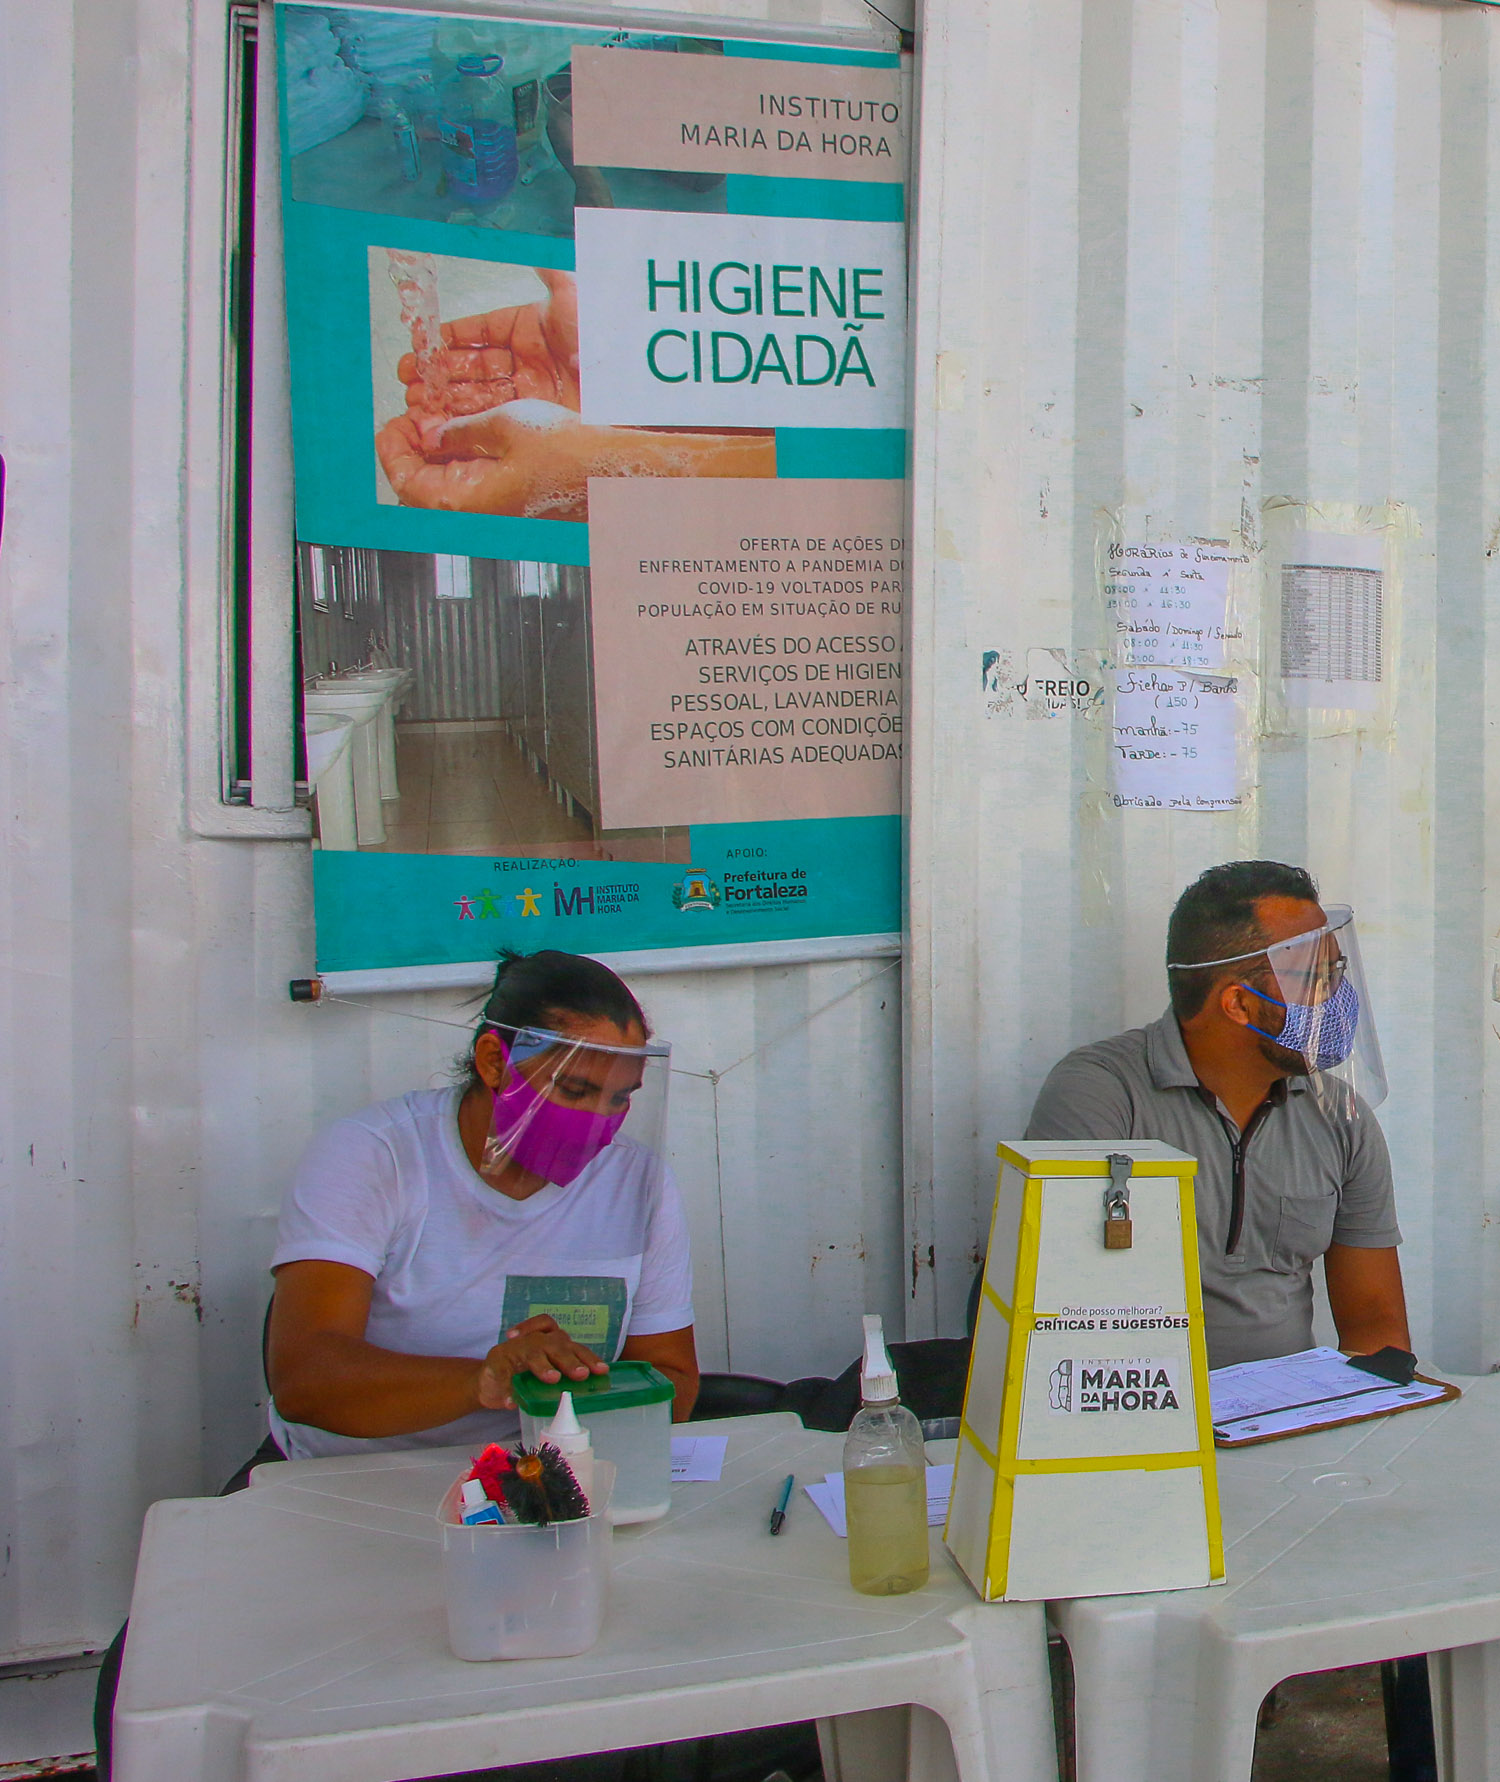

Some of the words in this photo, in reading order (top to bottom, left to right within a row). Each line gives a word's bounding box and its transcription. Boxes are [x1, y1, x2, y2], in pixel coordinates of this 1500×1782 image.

[759, 93, 899, 124] INSTITUTO
[681, 124, 768, 149] MARIA
[776, 130, 813, 152] DA
[821, 133, 892, 158] HORA
[647, 259, 885, 320] HIGIENE
[646, 321, 877, 388] CIDADÃ
[740, 538, 800, 551] OFERTA
[807, 538, 825, 551] DE
[832, 536, 883, 554] AÇÕES
[639, 560, 780, 573] ENFRENTAMENTO
[787, 560, 795, 572] A
[802, 559, 882, 572] PANDEMIA
[698, 581, 775, 595] COVID-19
[782, 581, 864, 594] VOLTADOS
[871, 581, 904, 593] PAR
[1160, 585, 1186, 595] 11:30
[637, 601, 736, 619] POPULAÇÃO
[742, 603, 764, 616] EM
[770, 600, 850, 618] SITUAÇÃO
[856, 602, 874, 615] DE
[1161, 600, 1191, 609] 16:30
[685, 634, 776, 656] ATRAVÉS
[784, 637, 811, 654] DO
[816, 636, 896, 654] ACESSO
[1181, 642, 1203, 651] 11:30
[699, 664, 798, 686] SERVIÇOS
[806, 664, 830, 681] DE
[671, 693, 769, 713] PESSOAL,
[774, 690, 898, 709] LAVANDERIA
[651, 721, 744, 743] ESPAÇOS
[752, 720, 795, 737] COM
[664, 745, 784, 768] SANITÁRIAS
[726, 848, 767, 859] APOIO:
[724, 869, 787, 883] Prefeitura
[791, 868, 807, 879] de
[596, 883, 639, 894] INSTITUTO
[725, 883, 808, 901] Fortaleza
[597, 894, 625, 904] MARIA
[628, 893, 639, 903] DA
[597, 904, 622, 914] HORA
[1062, 1307, 1087, 1316] Onde
[1089, 1308, 1115, 1317] posso
[1118, 1306, 1163, 1315] melhorar?
[1035, 1317, 1095, 1330] CRÍTICAS
[1100, 1319, 1107, 1330] E
[1112, 1316, 1189, 1330] SUGESTÕES
[1081, 1369, 1170, 1389] MARIA
[1081, 1393, 1100, 1403] DA
[1102, 1390, 1179, 1411] HORA
